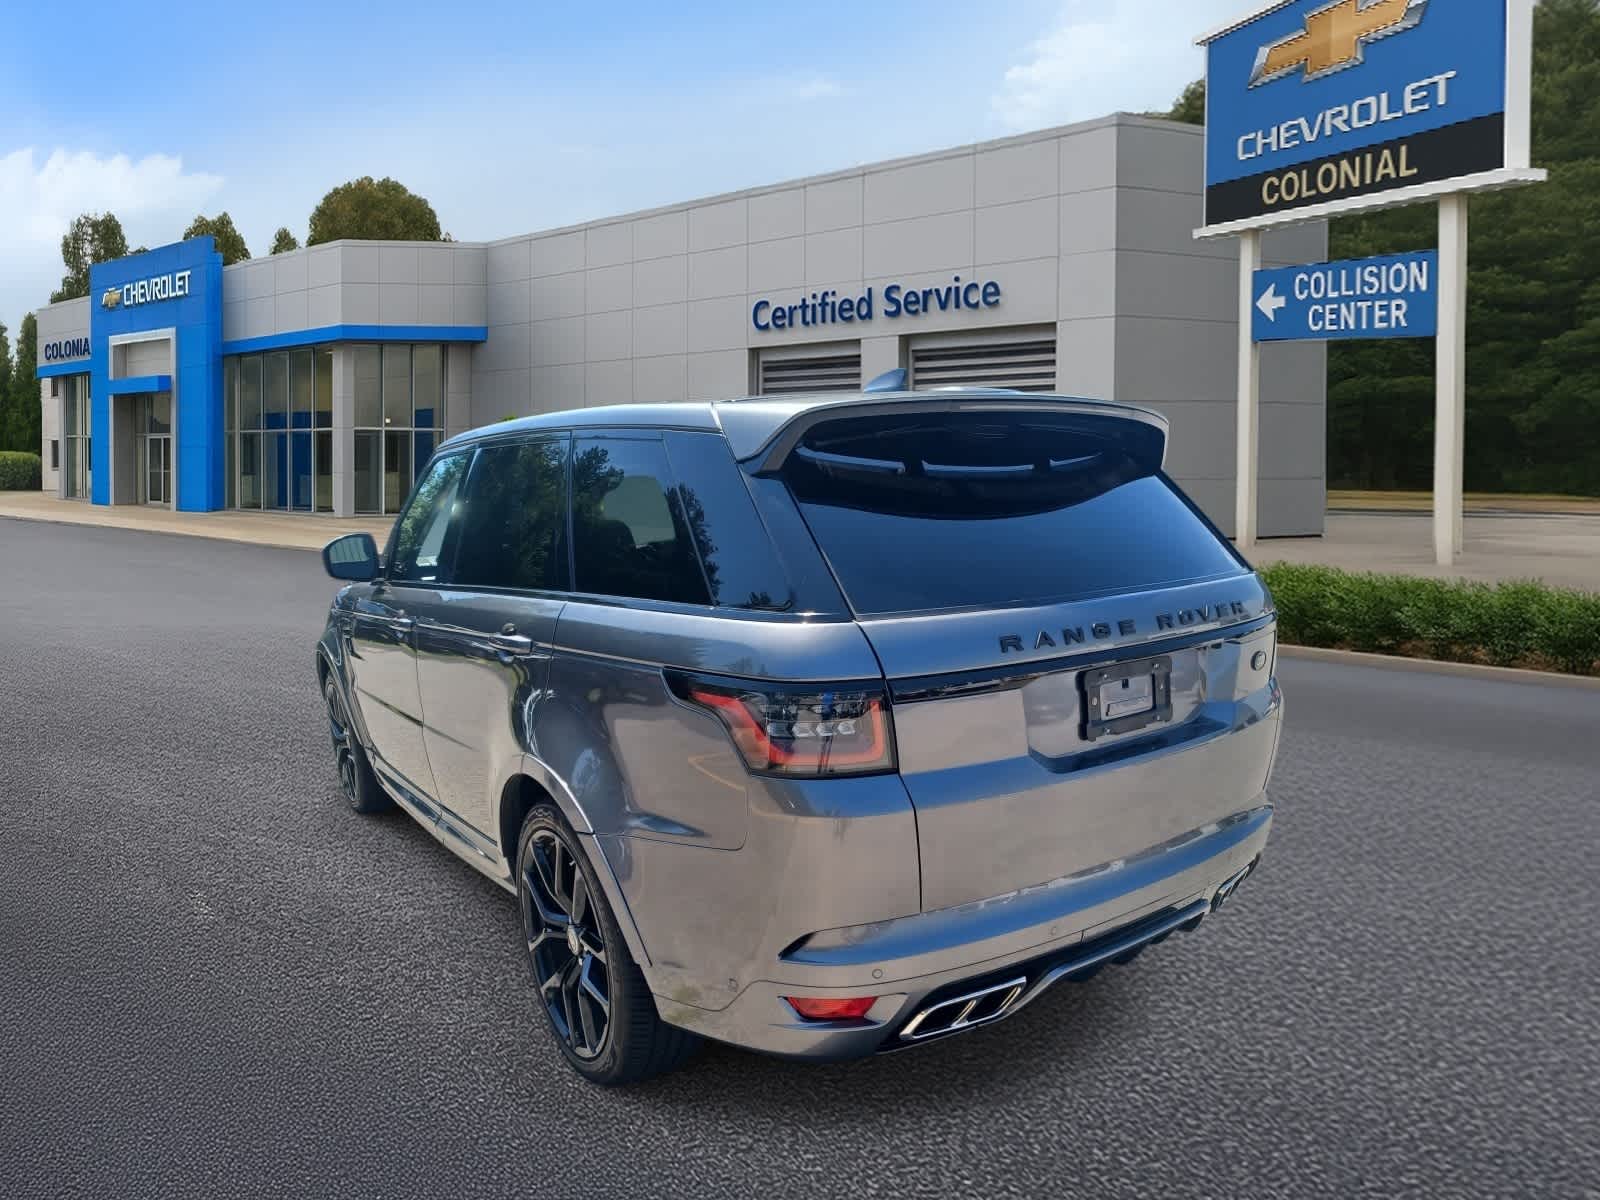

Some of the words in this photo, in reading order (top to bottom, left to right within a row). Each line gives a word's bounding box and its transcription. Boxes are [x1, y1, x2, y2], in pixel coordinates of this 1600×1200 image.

[1237, 70, 1456, 161] CHEVROLET
[1262, 144, 1418, 205] COLONIAL
[122, 270, 191, 306] CHEVROLET
[752, 287, 873, 330] Certified
[883, 275, 1001, 318] Service
[1294, 260, 1428, 300] COLLISION
[1308, 299, 1408, 331] CENTER
[44, 337, 91, 361] COLONIA
[999, 619, 1137, 653] RANGE
[1155, 600, 1247, 630] ROVER
